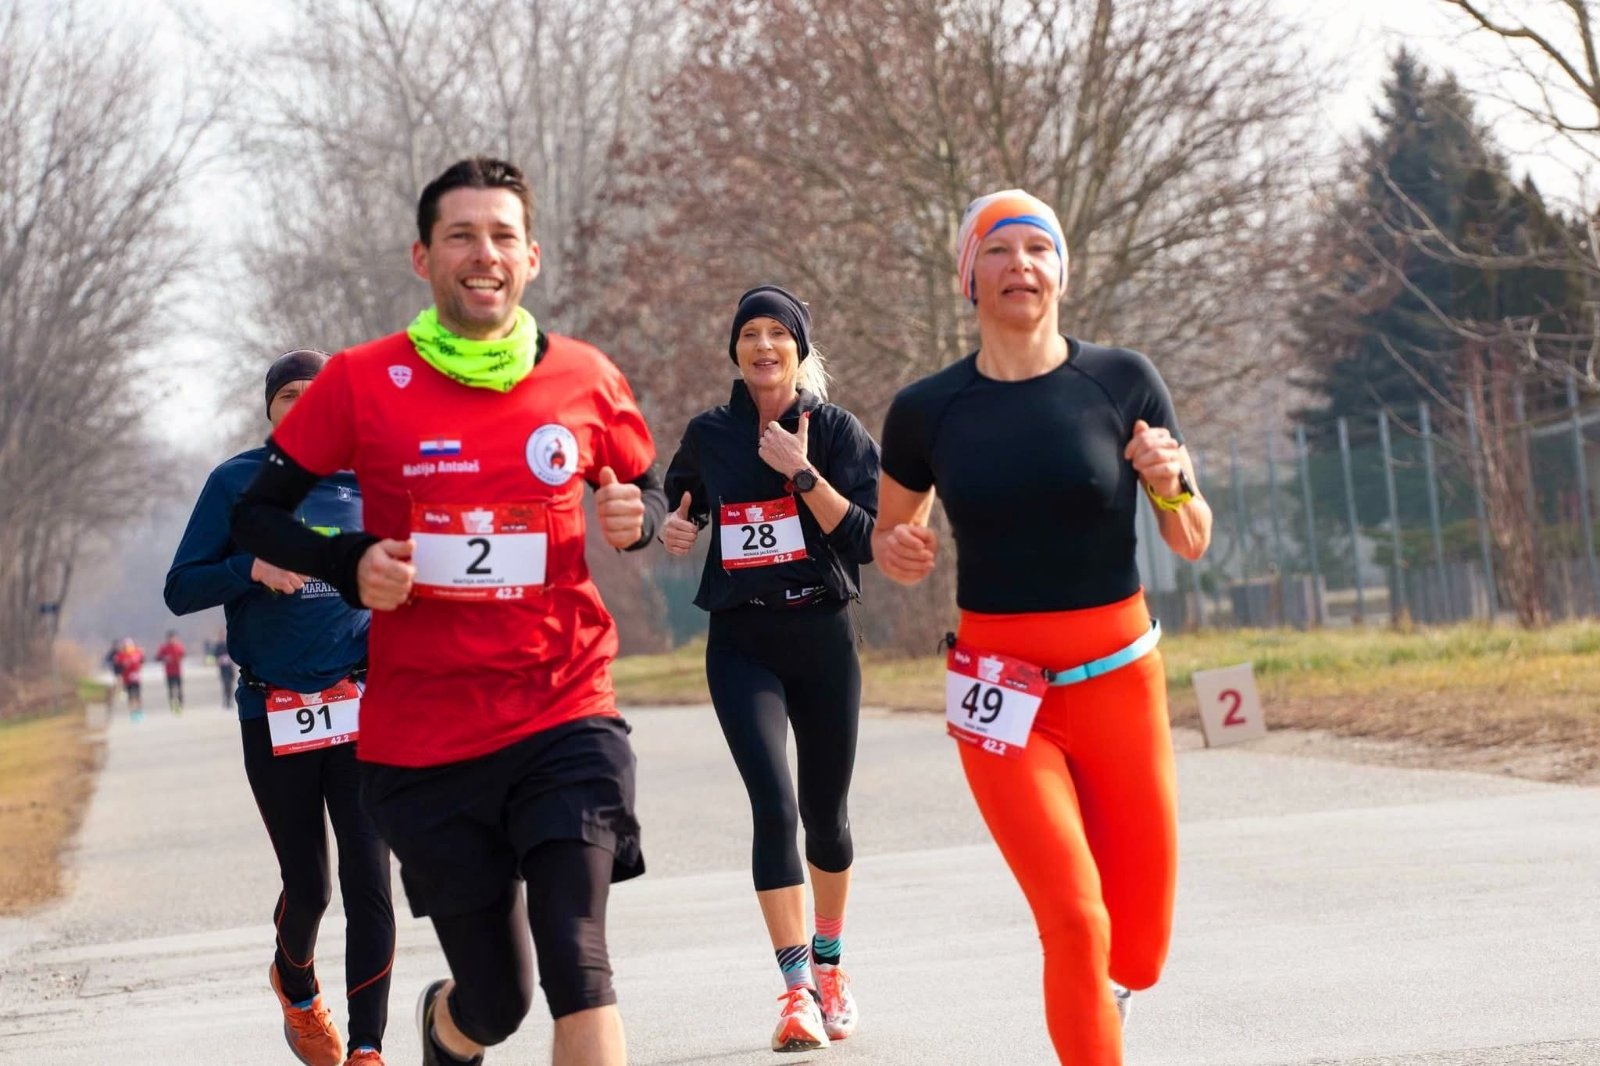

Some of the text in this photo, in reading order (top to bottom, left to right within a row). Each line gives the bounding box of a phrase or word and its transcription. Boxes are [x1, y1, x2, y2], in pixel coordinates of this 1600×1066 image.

[741, 524, 777, 551] 28
[466, 538, 492, 574] 2
[773, 553, 793, 564] 42.2
[495, 586, 524, 599] 42.2
[961, 682, 1003, 724] 49
[1218, 689, 1246, 727] 2
[296, 705, 332, 734] 91
[330, 734, 349, 745] 42.2
[982, 738, 1007, 756] 42.2
